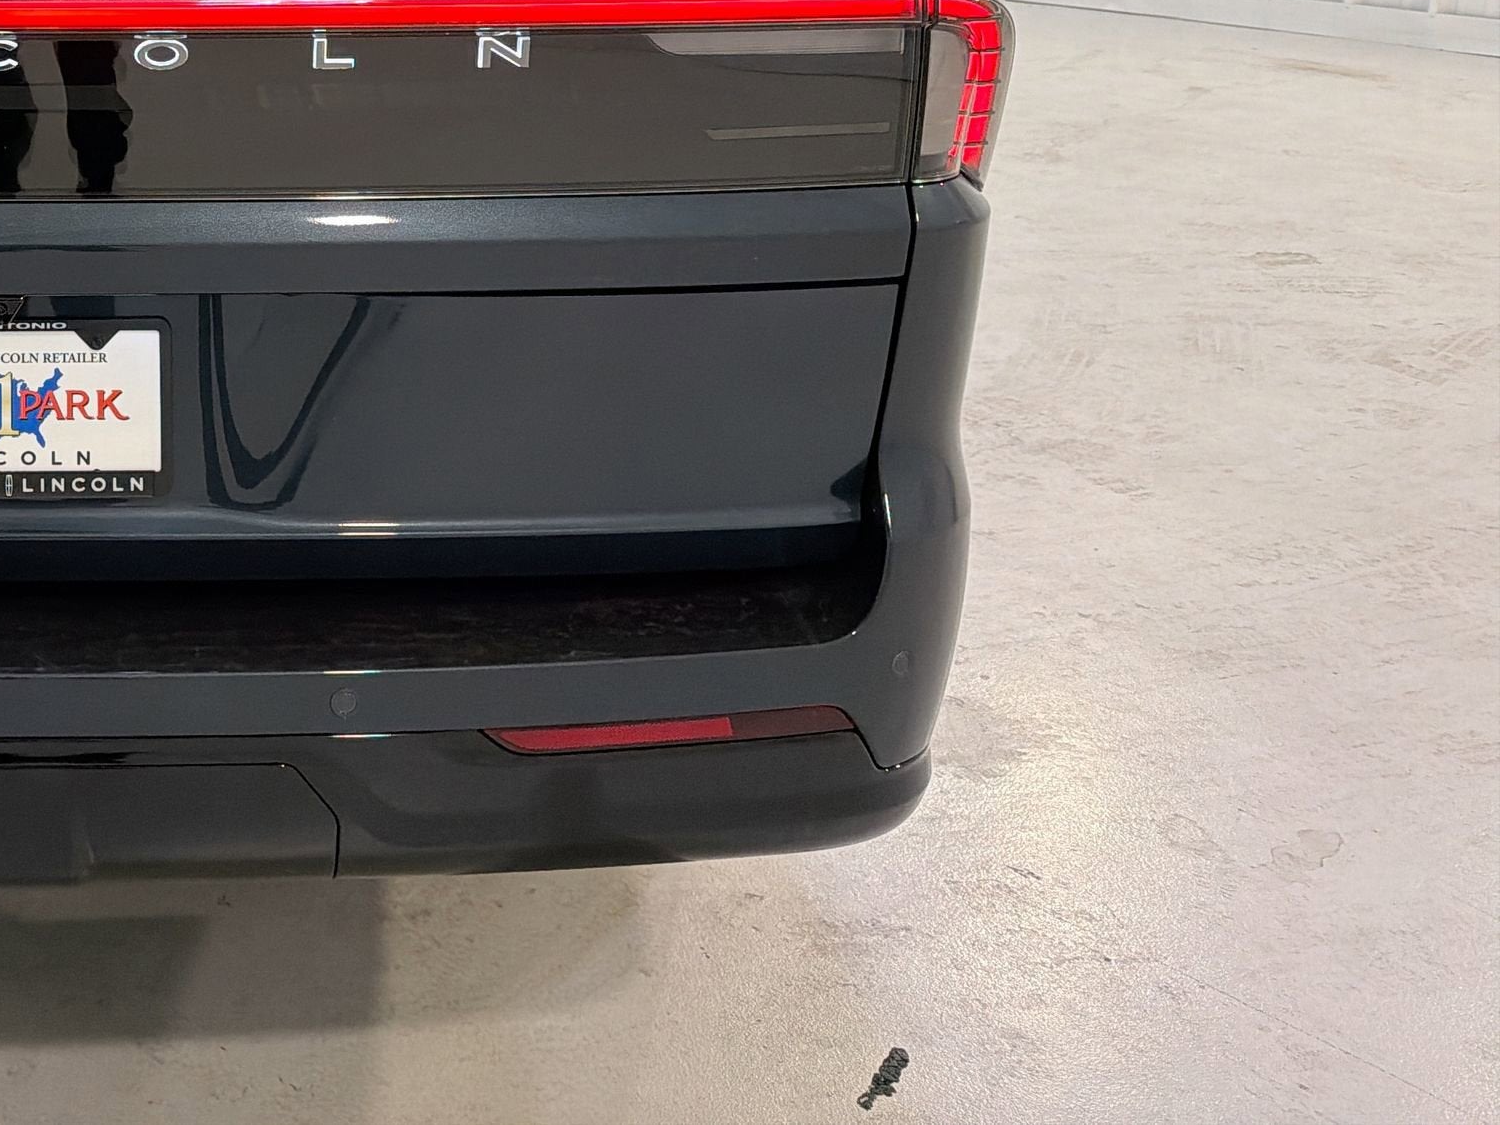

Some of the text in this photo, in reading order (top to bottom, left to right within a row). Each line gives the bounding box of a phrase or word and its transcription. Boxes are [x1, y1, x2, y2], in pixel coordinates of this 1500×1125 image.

[43, 352, 108, 364] RETAILER
[18, 389, 131, 421] PARK
[22, 476, 145, 493] LINCOLN
